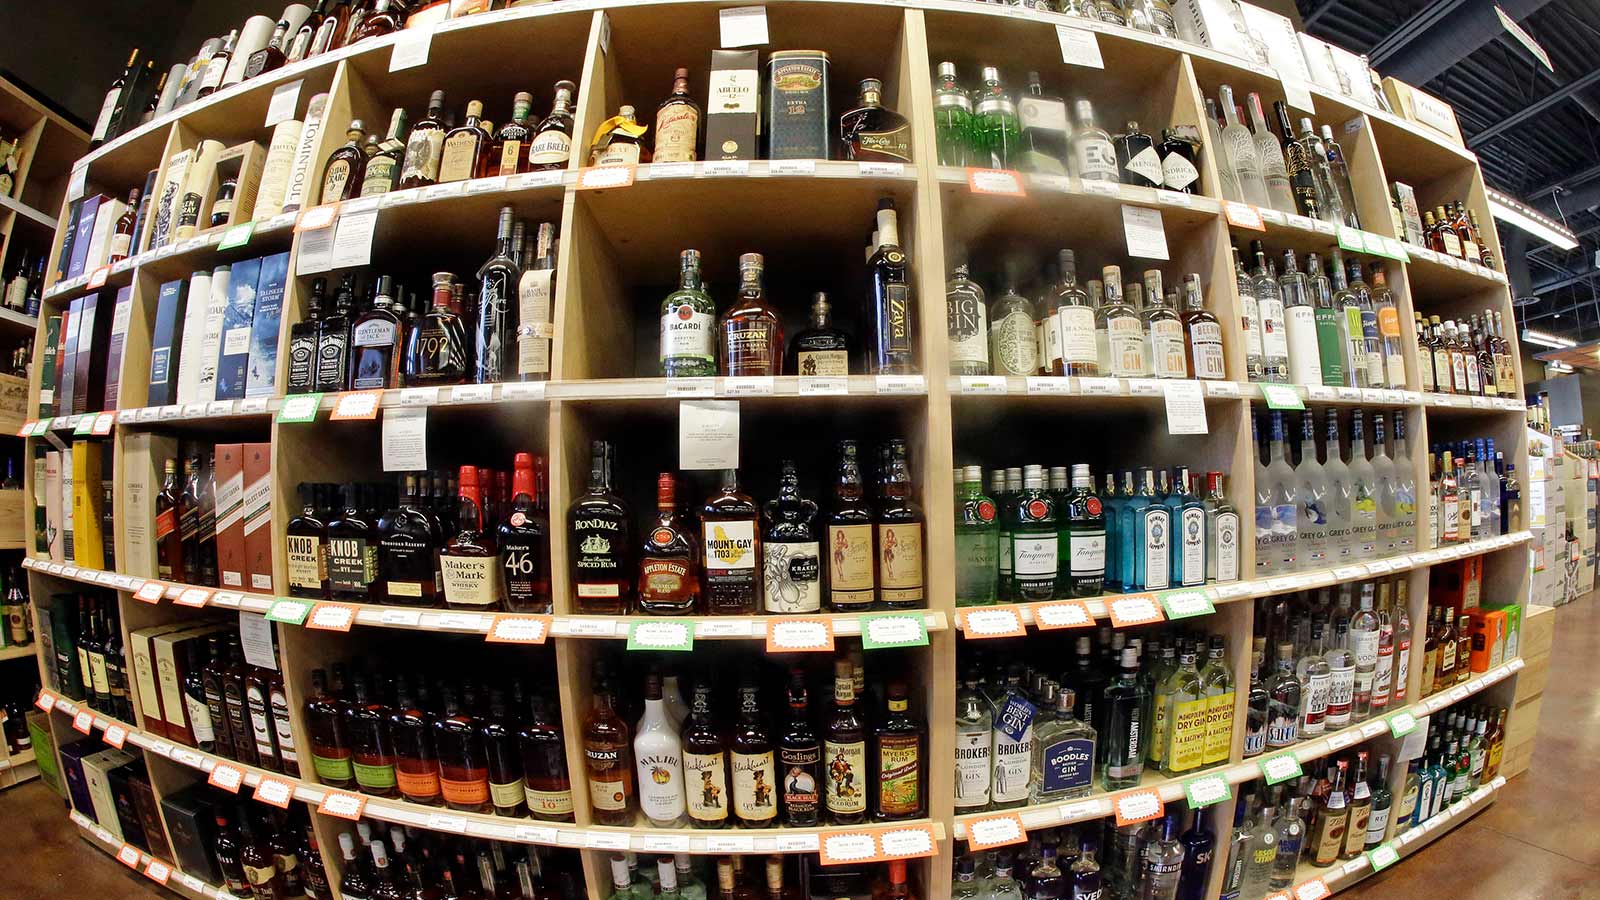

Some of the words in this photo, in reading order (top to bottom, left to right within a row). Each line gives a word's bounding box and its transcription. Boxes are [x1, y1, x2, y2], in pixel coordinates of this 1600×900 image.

[507, 146, 514, 155] 6
[546, 142, 570, 152] BREED
[291, 119, 321, 201] TOMINTOUL
[947, 300, 973, 314] BIG
[890, 299, 905, 339] Zaya
[357, 327, 391, 336] GENTLEMAN
[416, 337, 449, 360] 1792
[1122, 354, 1142, 370] GIN
[1167, 355, 1184, 372] GIN
[1207, 357, 1223, 373] GIN
[575, 519, 618, 531] RONDIAZ
[1352, 526, 1367, 534] GREY
[1271, 535, 1288, 543] GREY
[1300, 531, 1316, 539] GREY
[1329, 529, 1344, 537] GREY
[287, 537, 312, 554] KNOB
[330, 540, 358, 557] KNOB
[707, 540, 735, 549] MOUNT
[736, 539, 752, 549] GAY
[714, 550, 730, 558] 1703
[334, 558, 363, 566] CREEK
[445, 560, 485, 569] Maker's
[506, 551, 534, 576] 46
[644, 564, 669, 575] APPLETON
[668, 563, 687, 576] ESTATE
[456, 572, 485, 580] Mark
[1006, 705, 1030, 722] BEST
[1009, 700, 1032, 715] WORLD'S
[1002, 713, 1026, 732] GIN
[1207, 714, 1222, 723] DRY
[1177, 720, 1193, 730] DRY
[1128, 721, 1140, 759] AMSTERDAM
[640, 755, 680, 768] MALIBU
[781, 752, 817, 762] Goslings
[1051, 753, 1090, 766] BOODLES
[881, 769, 902, 780] Original
